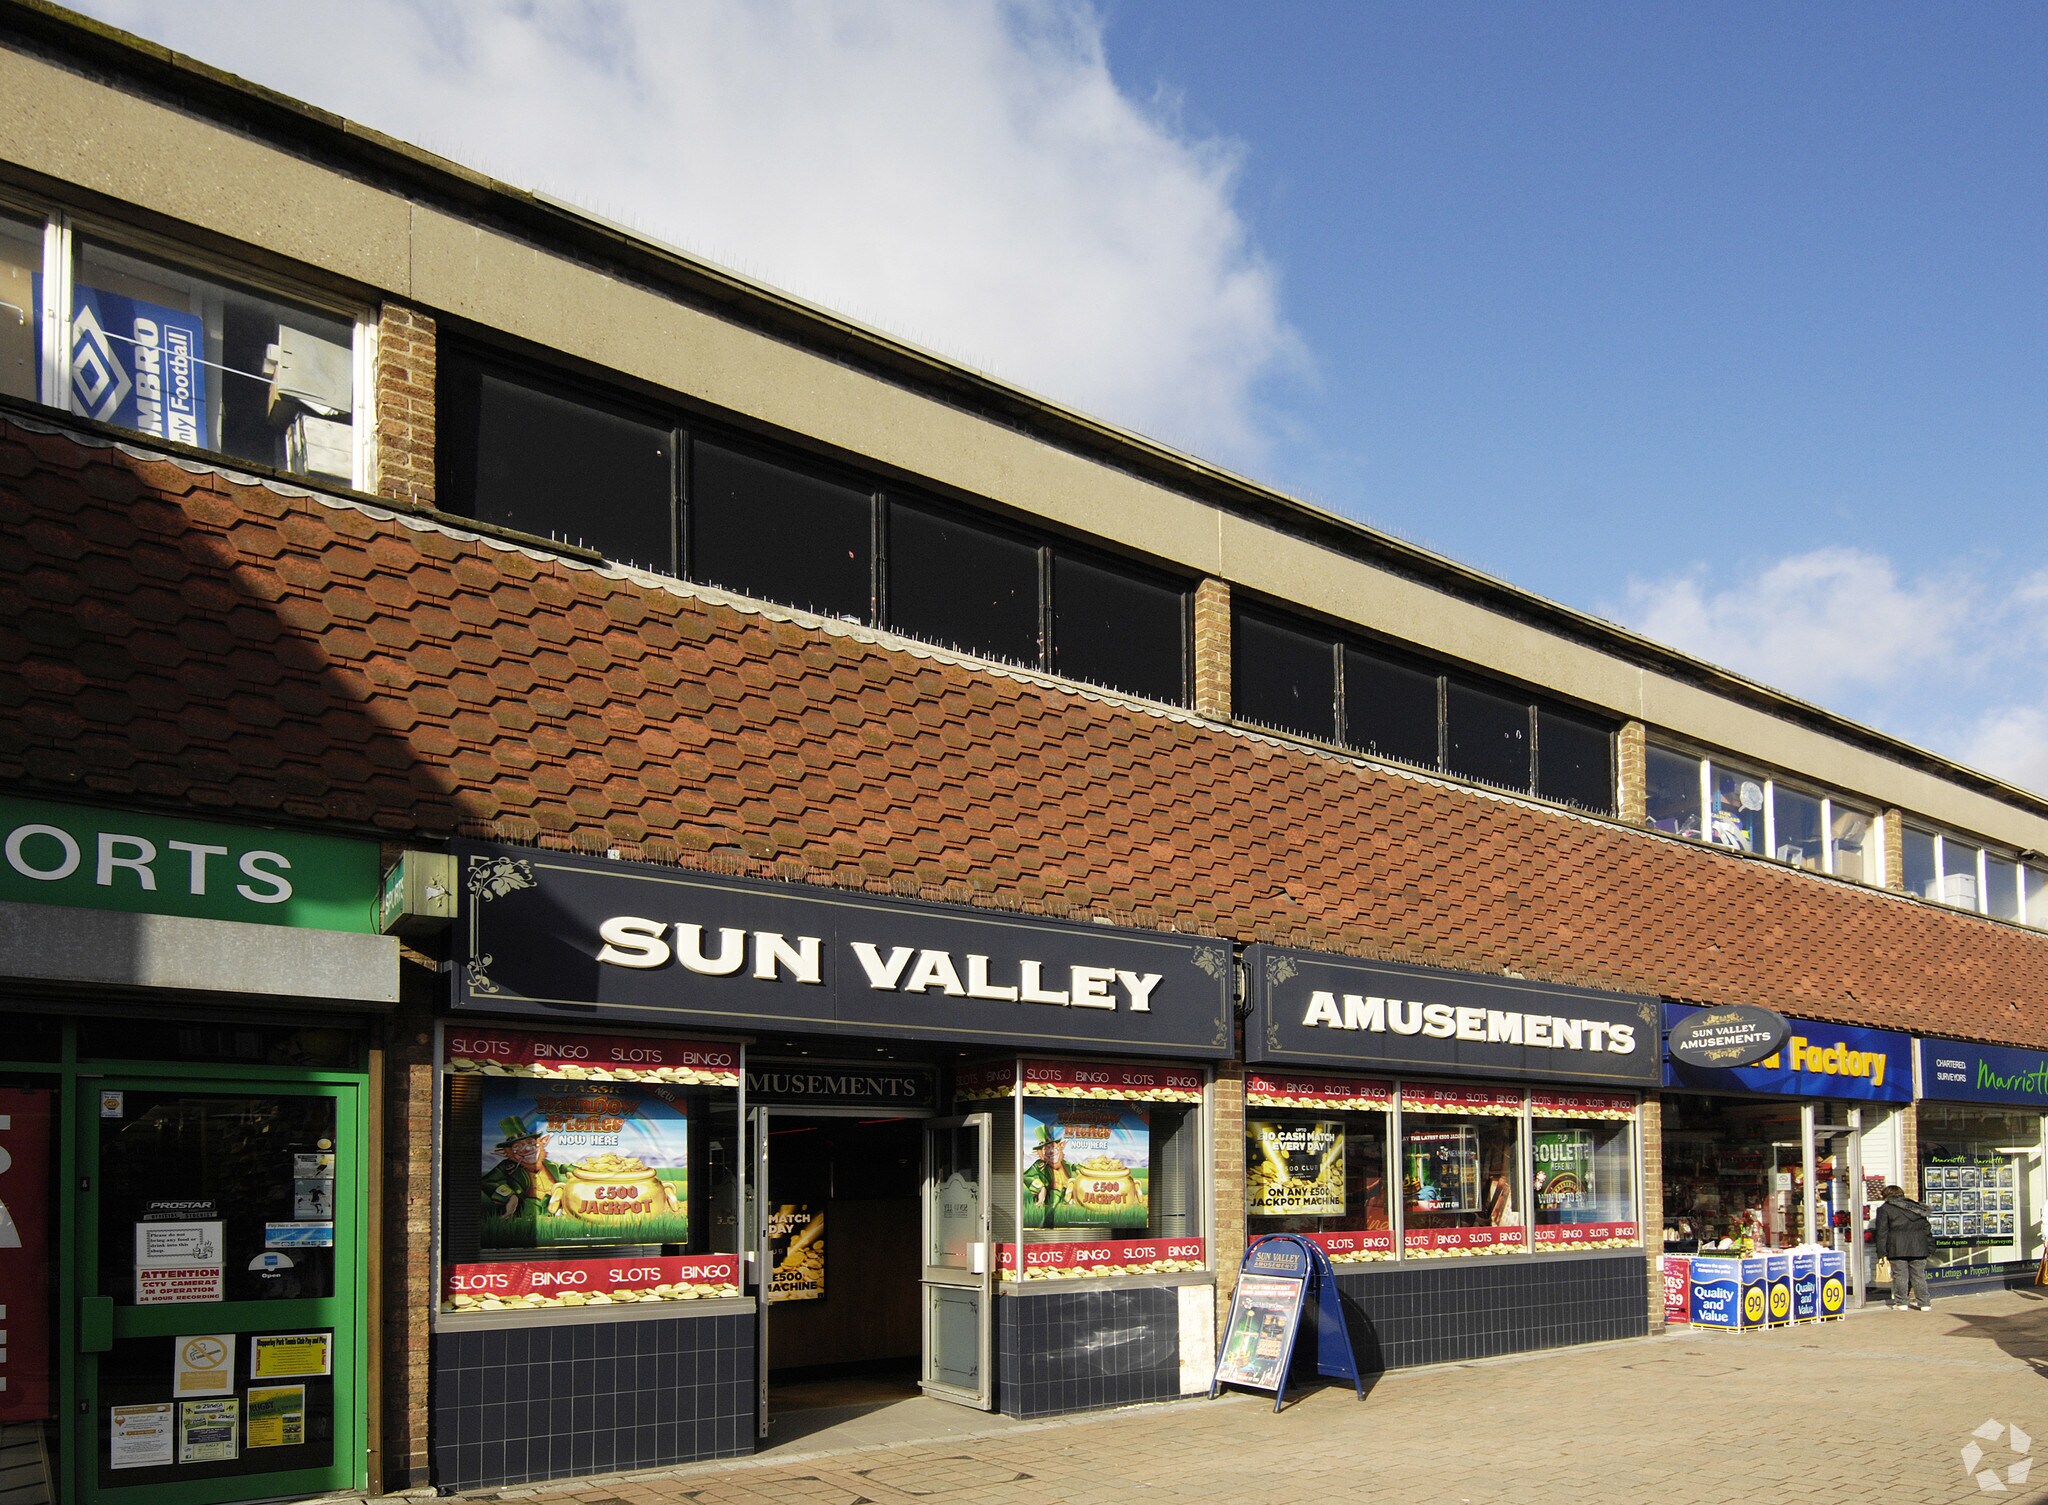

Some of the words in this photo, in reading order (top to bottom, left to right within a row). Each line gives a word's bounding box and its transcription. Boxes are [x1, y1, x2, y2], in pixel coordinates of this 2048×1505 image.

[168, 331, 190, 412] Football
[173, 416, 197, 443] nly
[4, 823, 294, 904] ORTS
[596, 915, 822, 983] SUN
[850, 939, 1163, 1013] VALLEY
[1302, 990, 1636, 1055] AMUSEMENTS
[1692, 1029, 1713, 1039] SUN
[1716, 1023, 1756, 1035] VALLEY
[1680, 1031, 1772, 1050] AMUSEMENTS
[451, 1038, 511, 1055] SLOTS
[533, 1043, 589, 1059] BINGO
[611, 1047, 663, 1063] SLOTS
[683, 1051, 731, 1066] BINGO
[1789, 1035, 1887, 1087] Factory
[1936, 1058, 1967, 1070] CHARTERED
[1026, 1068, 1062, 1081] SLOTS
[1075, 1071, 1110, 1083] BINGO
[1122, 1073, 1155, 1086] SLOTS
[1167, 1075, 1198, 1088] BINGO
[1937, 1071, 1967, 1082] SURVEYORS
[551, 1083, 626, 1094] CLASSIC
[745, 1072, 916, 1097] MUSEMENTS
[1247, 1081, 1276, 1092] SLOTS
[1286, 1083, 1314, 1094] BINGO
[1324, 1085, 1351, 1096] SLOTS
[1361, 1087, 1387, 1098] BINGO
[653, 1087, 676, 1103] NEW
[1402, 1089, 1425, 1100] SLOTS
[1434, 1091, 1458, 1101] BINGO
[1466, 1093, 1489, 1103] SLOTS
[1497, 1094, 1519, 1104] BINGO
[535, 1095, 640, 1116] Rainbow
[1531, 1096, 1551, 1105] SLOTS
[1558, 1097, 1578, 1107] BINGO
[1586, 1099, 1605, 1108] SLOTS
[1611, 1100, 1630, 1109] BINGO
[546, 1114, 625, 1133] Riches
[558, 1134, 587, 1146] NOW
[590, 1134, 619, 1146] HERE
[1277, 1131, 1306, 1142] CASH
[1307, 1132, 1335, 1142] MATCH
[1071, 1140, 1089, 1150] NOW
[1090, 1141, 1108, 1150] HERE
[1272, 1141, 1306, 1151] EVERY
[1307, 1142, 1325, 1151] DAY
[1532, 1143, 1589, 1162] ROULETTE
[594, 1185, 639, 1200] £500
[1093, 1181, 1120, 1192] £500
[1268, 1188, 1285, 1197] ON
[1287, 1188, 1308, 1196] ANY
[150, 1201, 212, 1210] PROSTAR
[1084, 1193, 1128, 1205] JACKPOT
[1250, 1197, 1302, 1207] JACKPOT
[1303, 1196, 1340, 1206] MACHINE
[577, 1200, 653, 1216] JACKPOT
[768, 1213, 811, 1223] MATCH
[768, 1224, 794, 1234] DAY
[1534, 1230, 1556, 1240] SLOTS
[1562, 1229, 1583, 1239] BINGO
[1589, 1228, 1609, 1238] SLOTS
[1615, 1227, 1635, 1237] BINGO
[1327, 1239, 1354, 1249] SLOTS
[1363, 1237, 1389, 1248] BINGO
[1405, 1236, 1429, 1246] SLOTS
[1437, 1234, 1461, 1244] BINGO
[1469, 1233, 1492, 1243] SLOTS
[1499, 1232, 1522, 1241] BINGO
[1027, 1251, 1063, 1263] SLOTS
[1076, 1249, 1111, 1261] BINGO
[1123, 1246, 1156, 1259] SLOTS
[1168, 1245, 1199, 1257] BINGO
[1256, 1252, 1272, 1261] SUN
[1272, 1253, 1300, 1263] VALLEY
[1253, 1261, 1298, 1270] AMUSEMENTS
[141, 1269, 219, 1279] ATTENTION
[449, 1273, 509, 1290] SLOTS
[531, 1270, 588, 1286] BINGO
[609, 1267, 662, 1282] SLOTS
[682, 1264, 731, 1279] BINGO
[1941, 1268, 1962, 1279] Lettings
[1694, 1286, 1734, 1302] Quality
[1795, 1281, 1815, 1295] Quality
[1702, 1299, 1724, 1310] and
[1800, 1293, 1812, 1304] and
[1698, 1309, 1729, 1322] Value
[1798, 1304, 1814, 1315] Value
